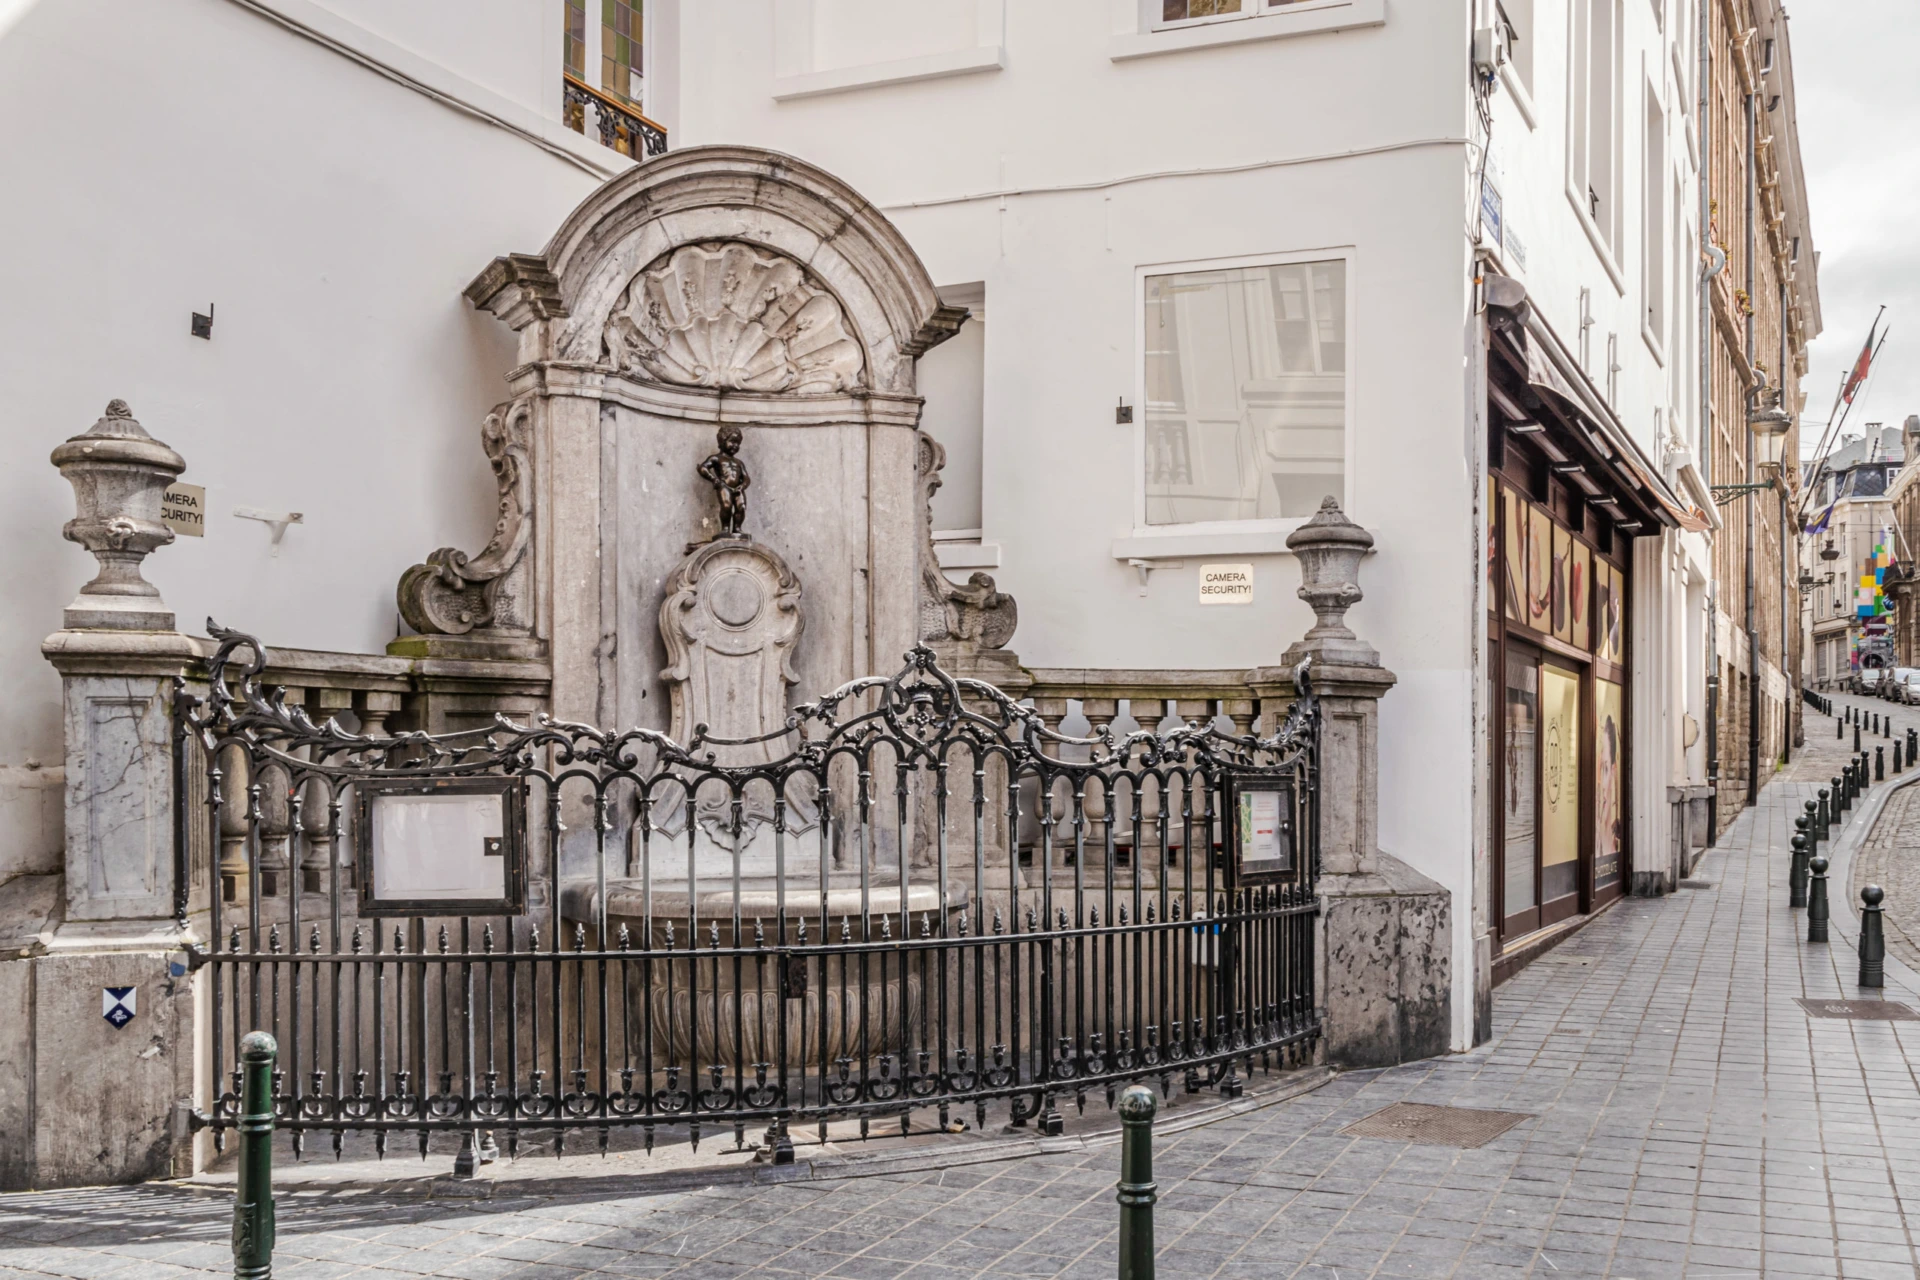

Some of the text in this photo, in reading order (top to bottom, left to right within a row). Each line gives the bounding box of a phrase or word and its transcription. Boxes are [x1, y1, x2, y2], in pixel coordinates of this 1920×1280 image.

[163, 492, 198, 507] MERA
[161, 507, 203, 524] CURITY!
[1206, 573, 1246, 582] CAMERA
[1201, 585, 1251, 594] SECURITY!
